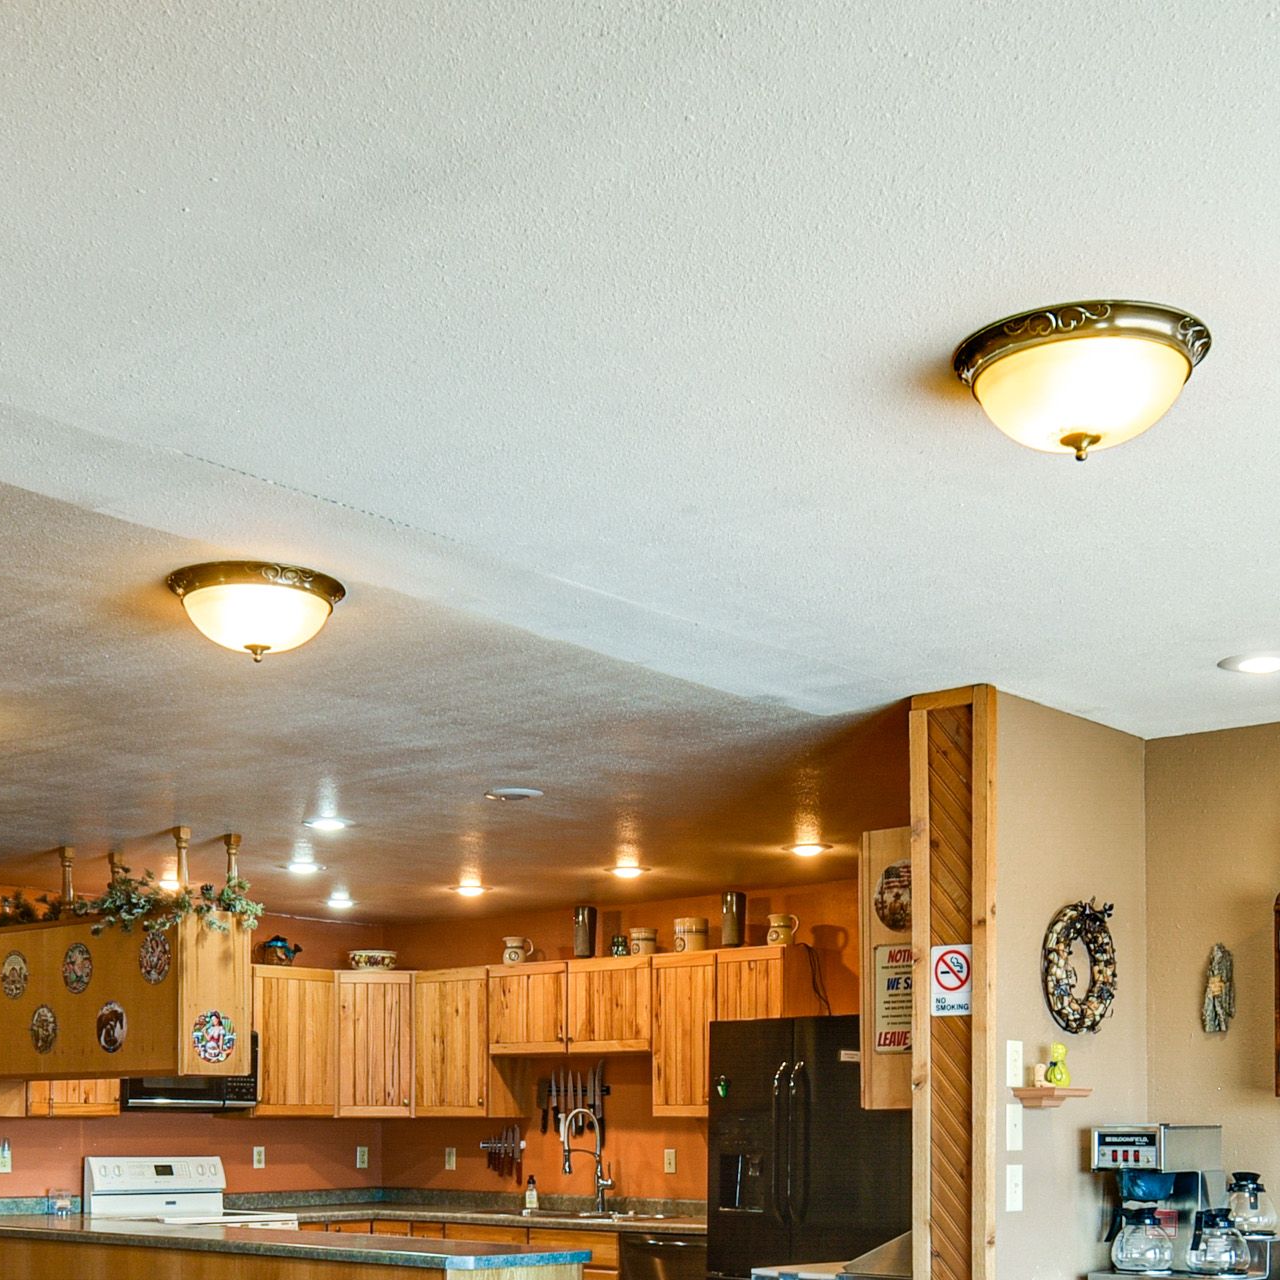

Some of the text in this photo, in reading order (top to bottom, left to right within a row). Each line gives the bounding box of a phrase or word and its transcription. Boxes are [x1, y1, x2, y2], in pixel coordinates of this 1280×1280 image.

[886, 977, 902, 991] WE
[935, 1003, 969, 1012] SMOKING
[877, 1031, 911, 1047] LEAVE
